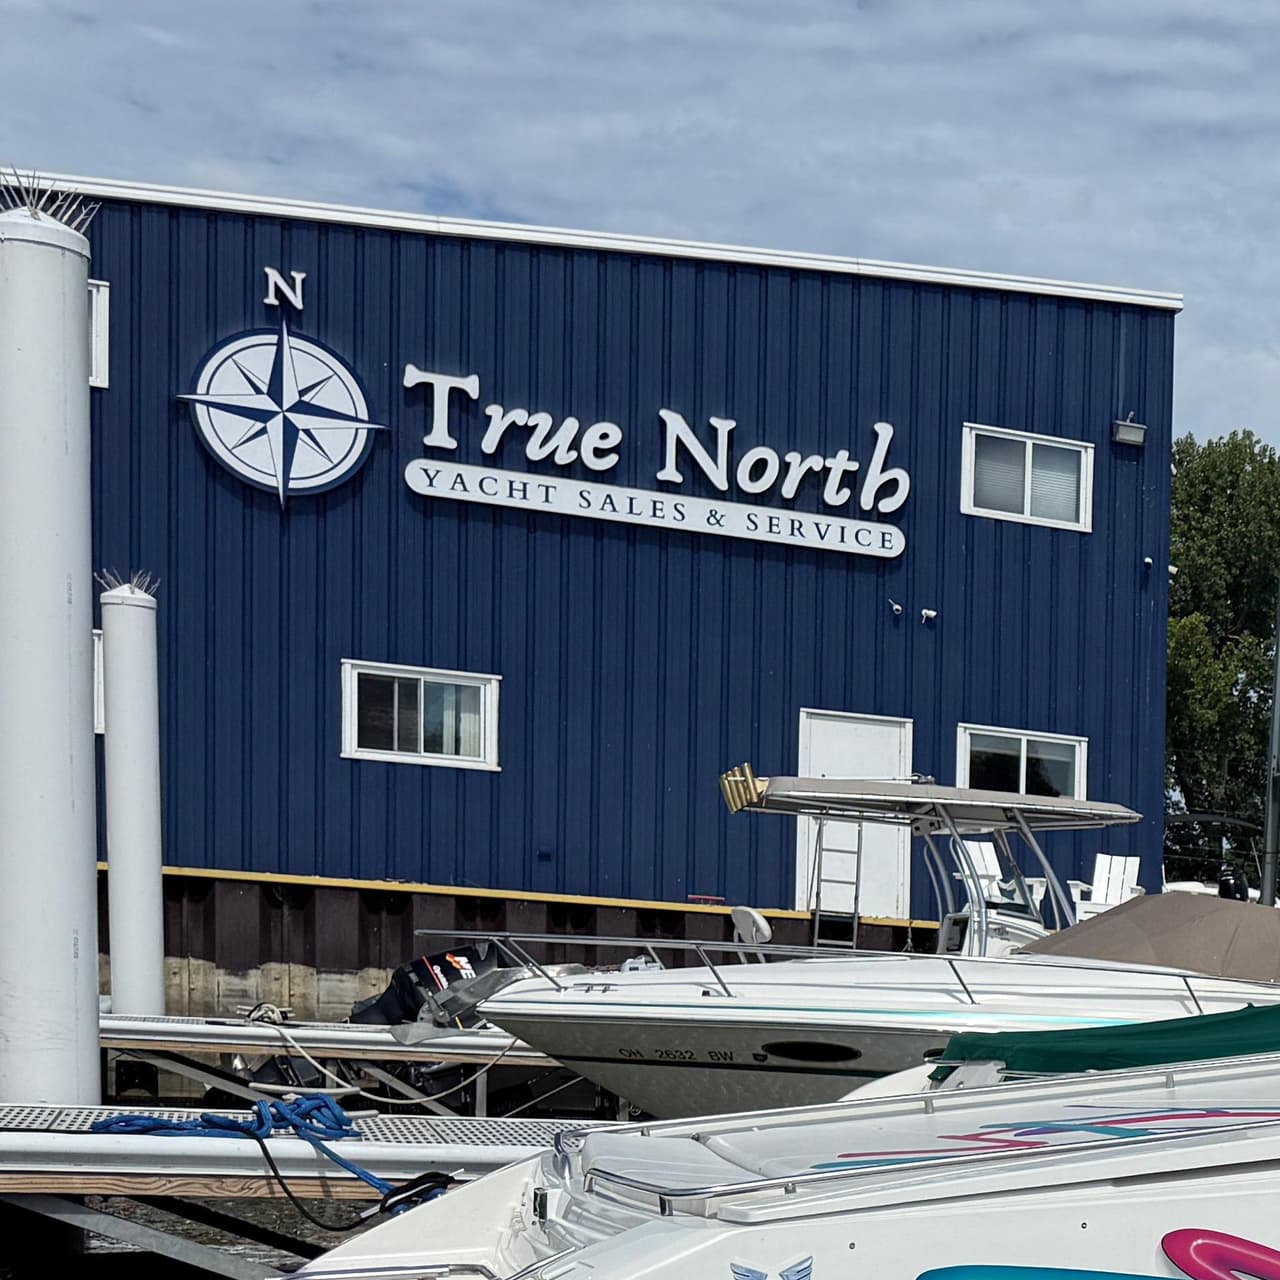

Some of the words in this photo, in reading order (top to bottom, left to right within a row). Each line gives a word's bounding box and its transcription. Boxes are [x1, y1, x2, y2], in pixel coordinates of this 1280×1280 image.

[263, 266, 307, 310] N
[403, 363, 623, 472] True
[656, 408, 911, 514] North
[419, 467, 558, 504] YACHT
[578, 489, 687, 523] SALES
[705, 508, 727, 528] &
[745, 512, 895, 551] SERVICE
[618, 1048, 645, 1059] OH
[655, 1049, 697, 1061] 2632
[707, 1050, 734, 1062] BW
